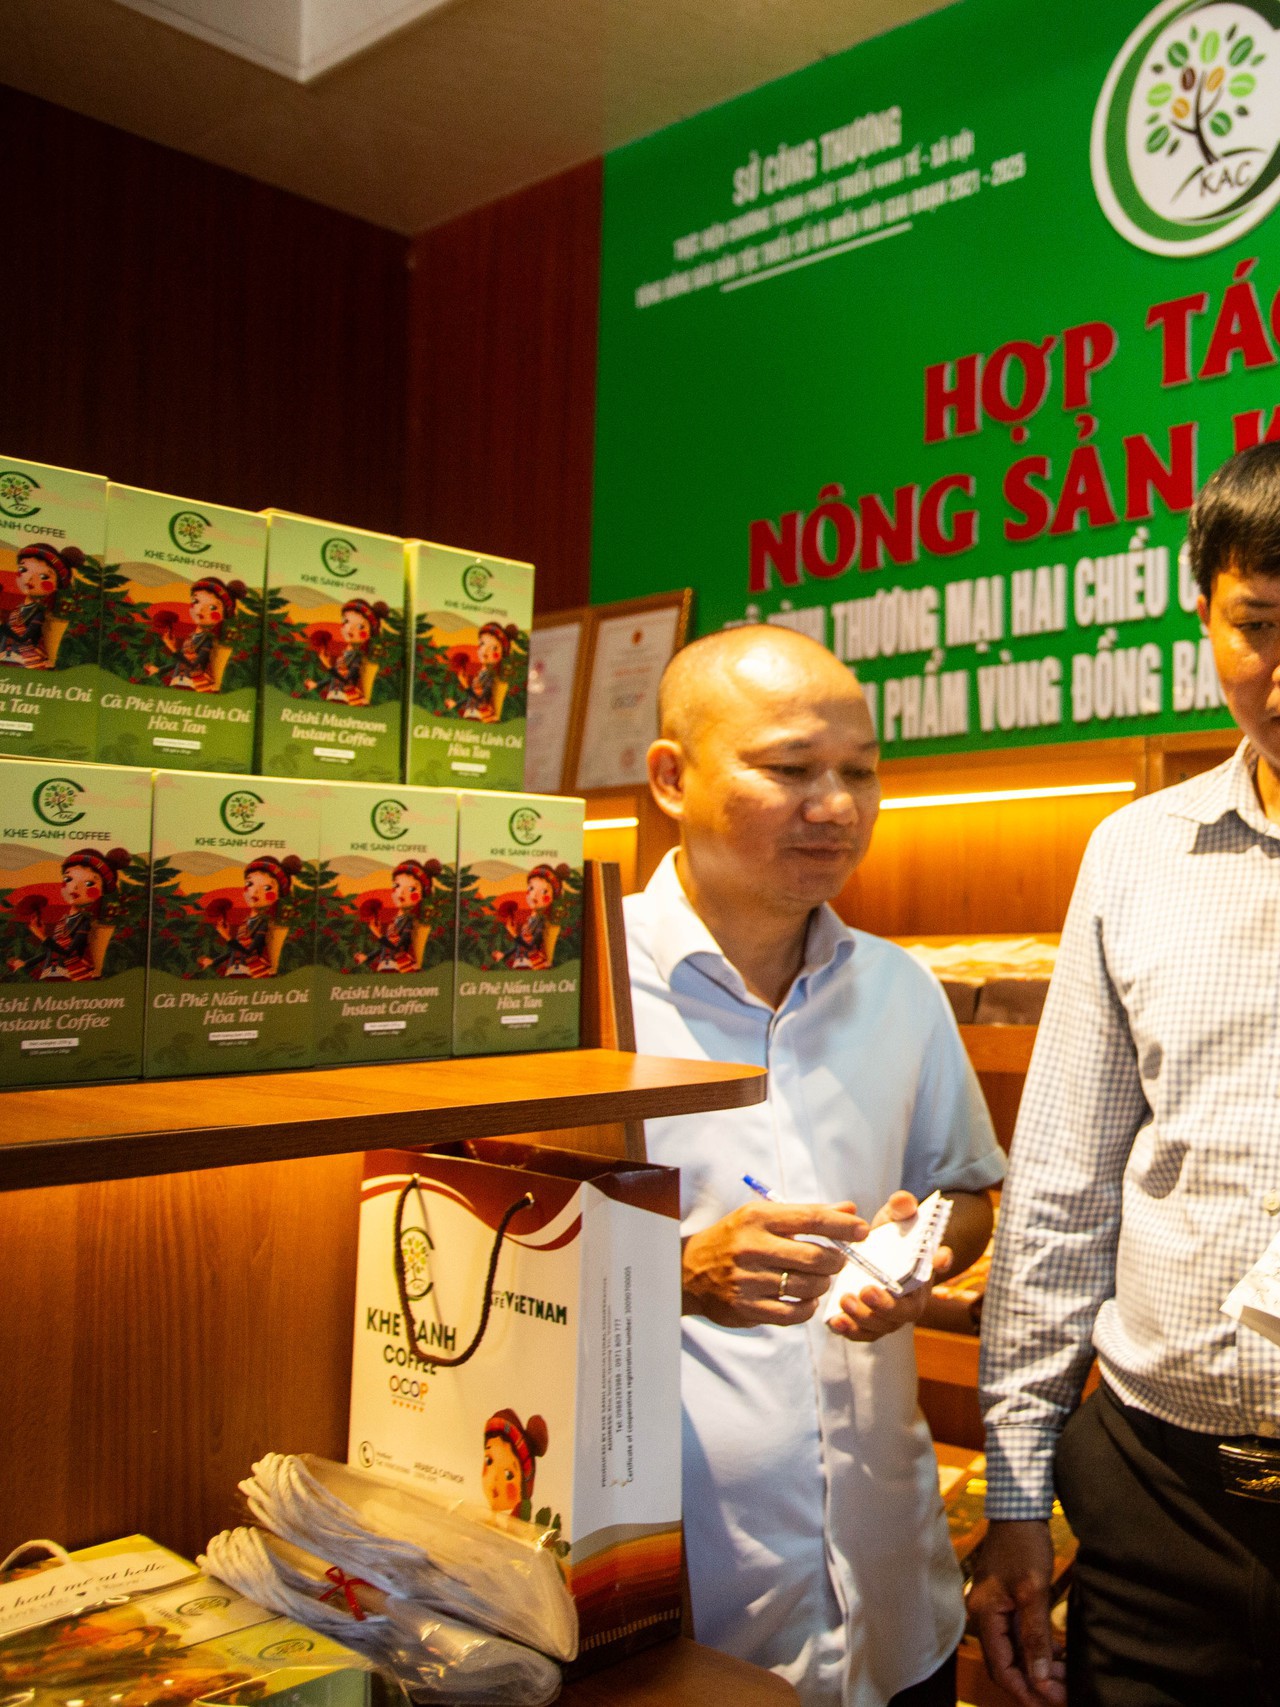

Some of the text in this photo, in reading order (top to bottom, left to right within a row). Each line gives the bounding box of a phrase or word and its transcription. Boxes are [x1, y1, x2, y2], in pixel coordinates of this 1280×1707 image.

[733, 149, 762, 206] SỞ
[1199, 160, 1252, 198] KAC
[923, 320, 1118, 445] HỢP
[749, 483, 979, 594] NÔNG
[1003, 413, 1198, 542] SẢN
[0, 520, 67, 539] ANH COFFEE
[143, 549, 232, 573] KHE SANH COFFEE
[944, 575, 1004, 655] MẠI
[1010, 563, 1067, 638] HAI
[1073, 526, 1170, 627] CHIỀU
[25, 682, 62, 700] Linh
[65, 686, 93, 703] Chi
[883, 646, 969, 743] PHẨM
[977, 648, 1062, 733] VÙNG
[1071, 627, 1162, 723] ĐỒNG
[1172, 623, 1229, 712] BÀ
[11, 698, 40, 715] Tan
[101, 693, 252, 723] Cà Phê Nấm Linh Chi
[147, 716, 207, 734] Hòa Tan
[280, 708, 387, 733] Reishi Mushroom
[291, 725, 377, 747] Instant Coffee
[3, 828, 111, 842] KHE SANH COFFEE
[195, 837, 286, 849] KHE SANH COFFEE
[153, 989, 310, 1009] Cà Phê Nấm Linh Chi
[330, 985, 440, 1001] Reishi Mushroom
[522, 995, 543, 1008] Tan
[0, 995, 125, 1013] ishi Mushroom
[341, 1000, 429, 1017] Instant Coffee
[0, 1012, 111, 1033] nstant Coffee
[203, 1008, 265, 1026] Hòa Tan
[366, 1307, 457, 1351] KHE ANH
[389, 1375, 429, 1400] OCOP
